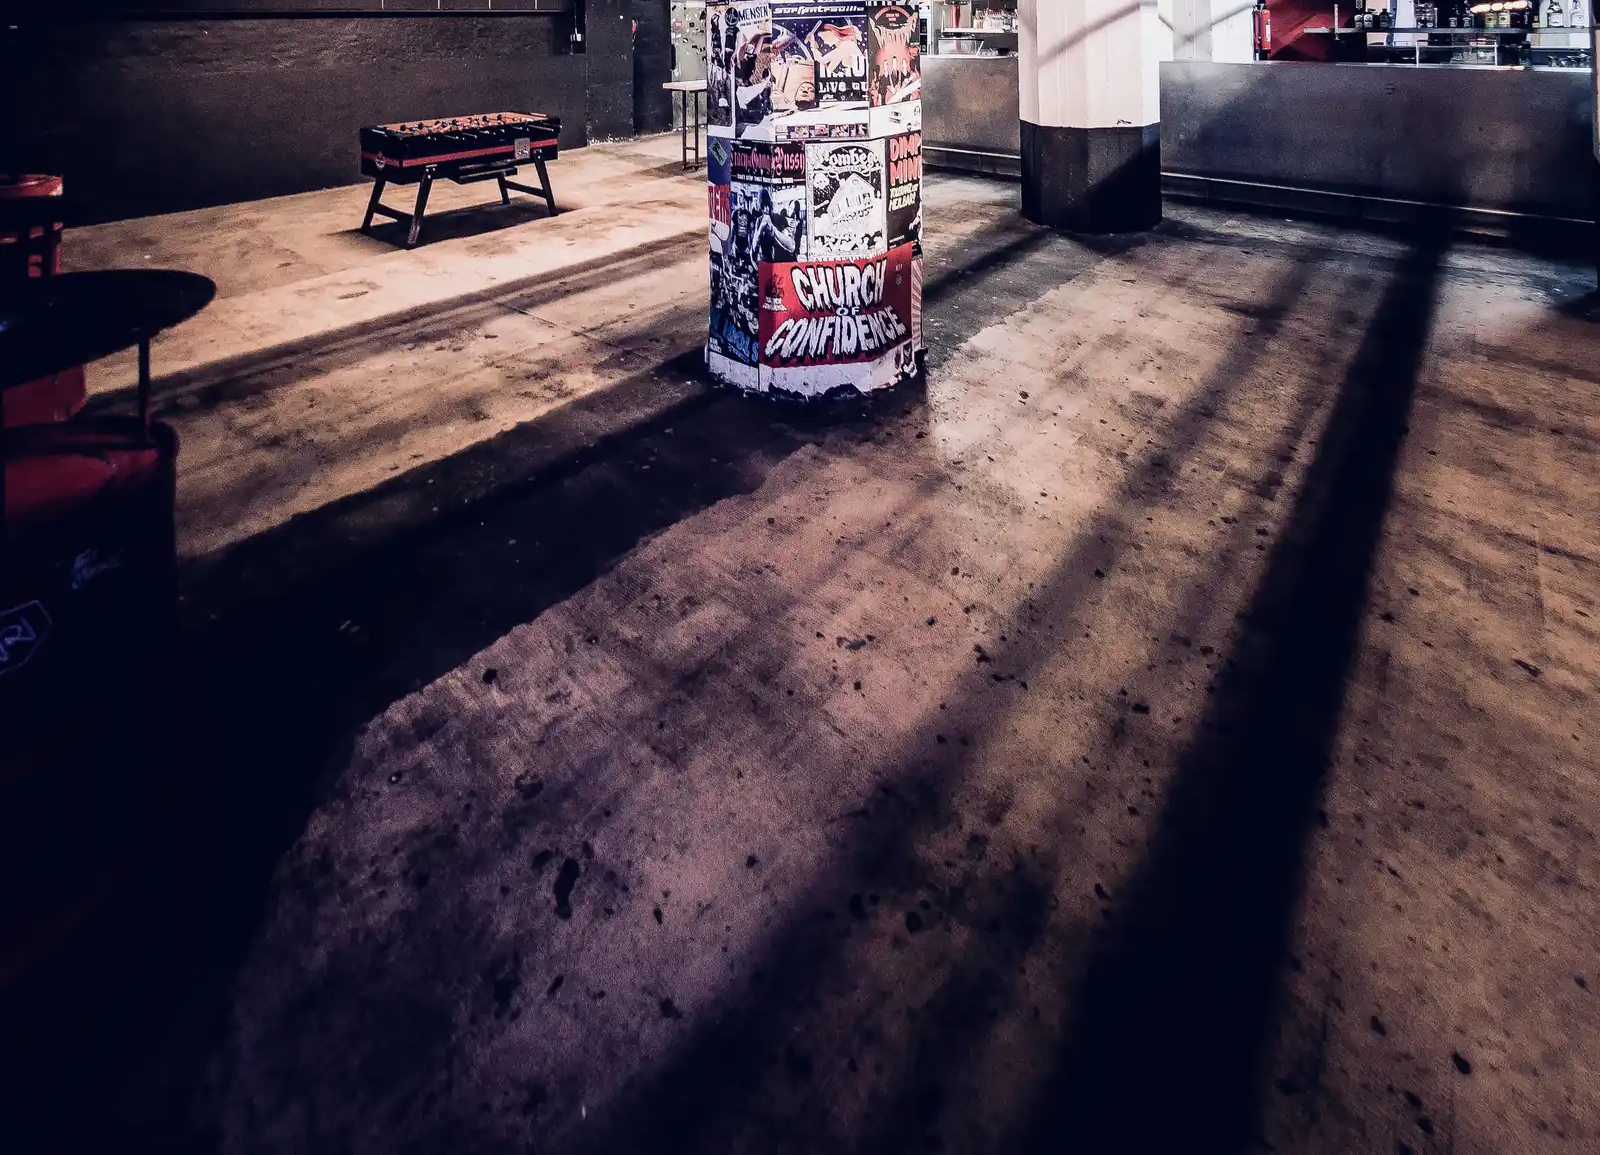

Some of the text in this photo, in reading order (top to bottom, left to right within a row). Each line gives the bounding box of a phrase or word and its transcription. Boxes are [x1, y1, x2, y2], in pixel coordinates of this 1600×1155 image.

[773, 146, 805, 176] Pussy
[889, 132, 921, 161] DIMP
[790, 256, 888, 311] CHURCH
[835, 306, 861, 316] OF
[764, 305, 907, 358] CONFIDENCE
